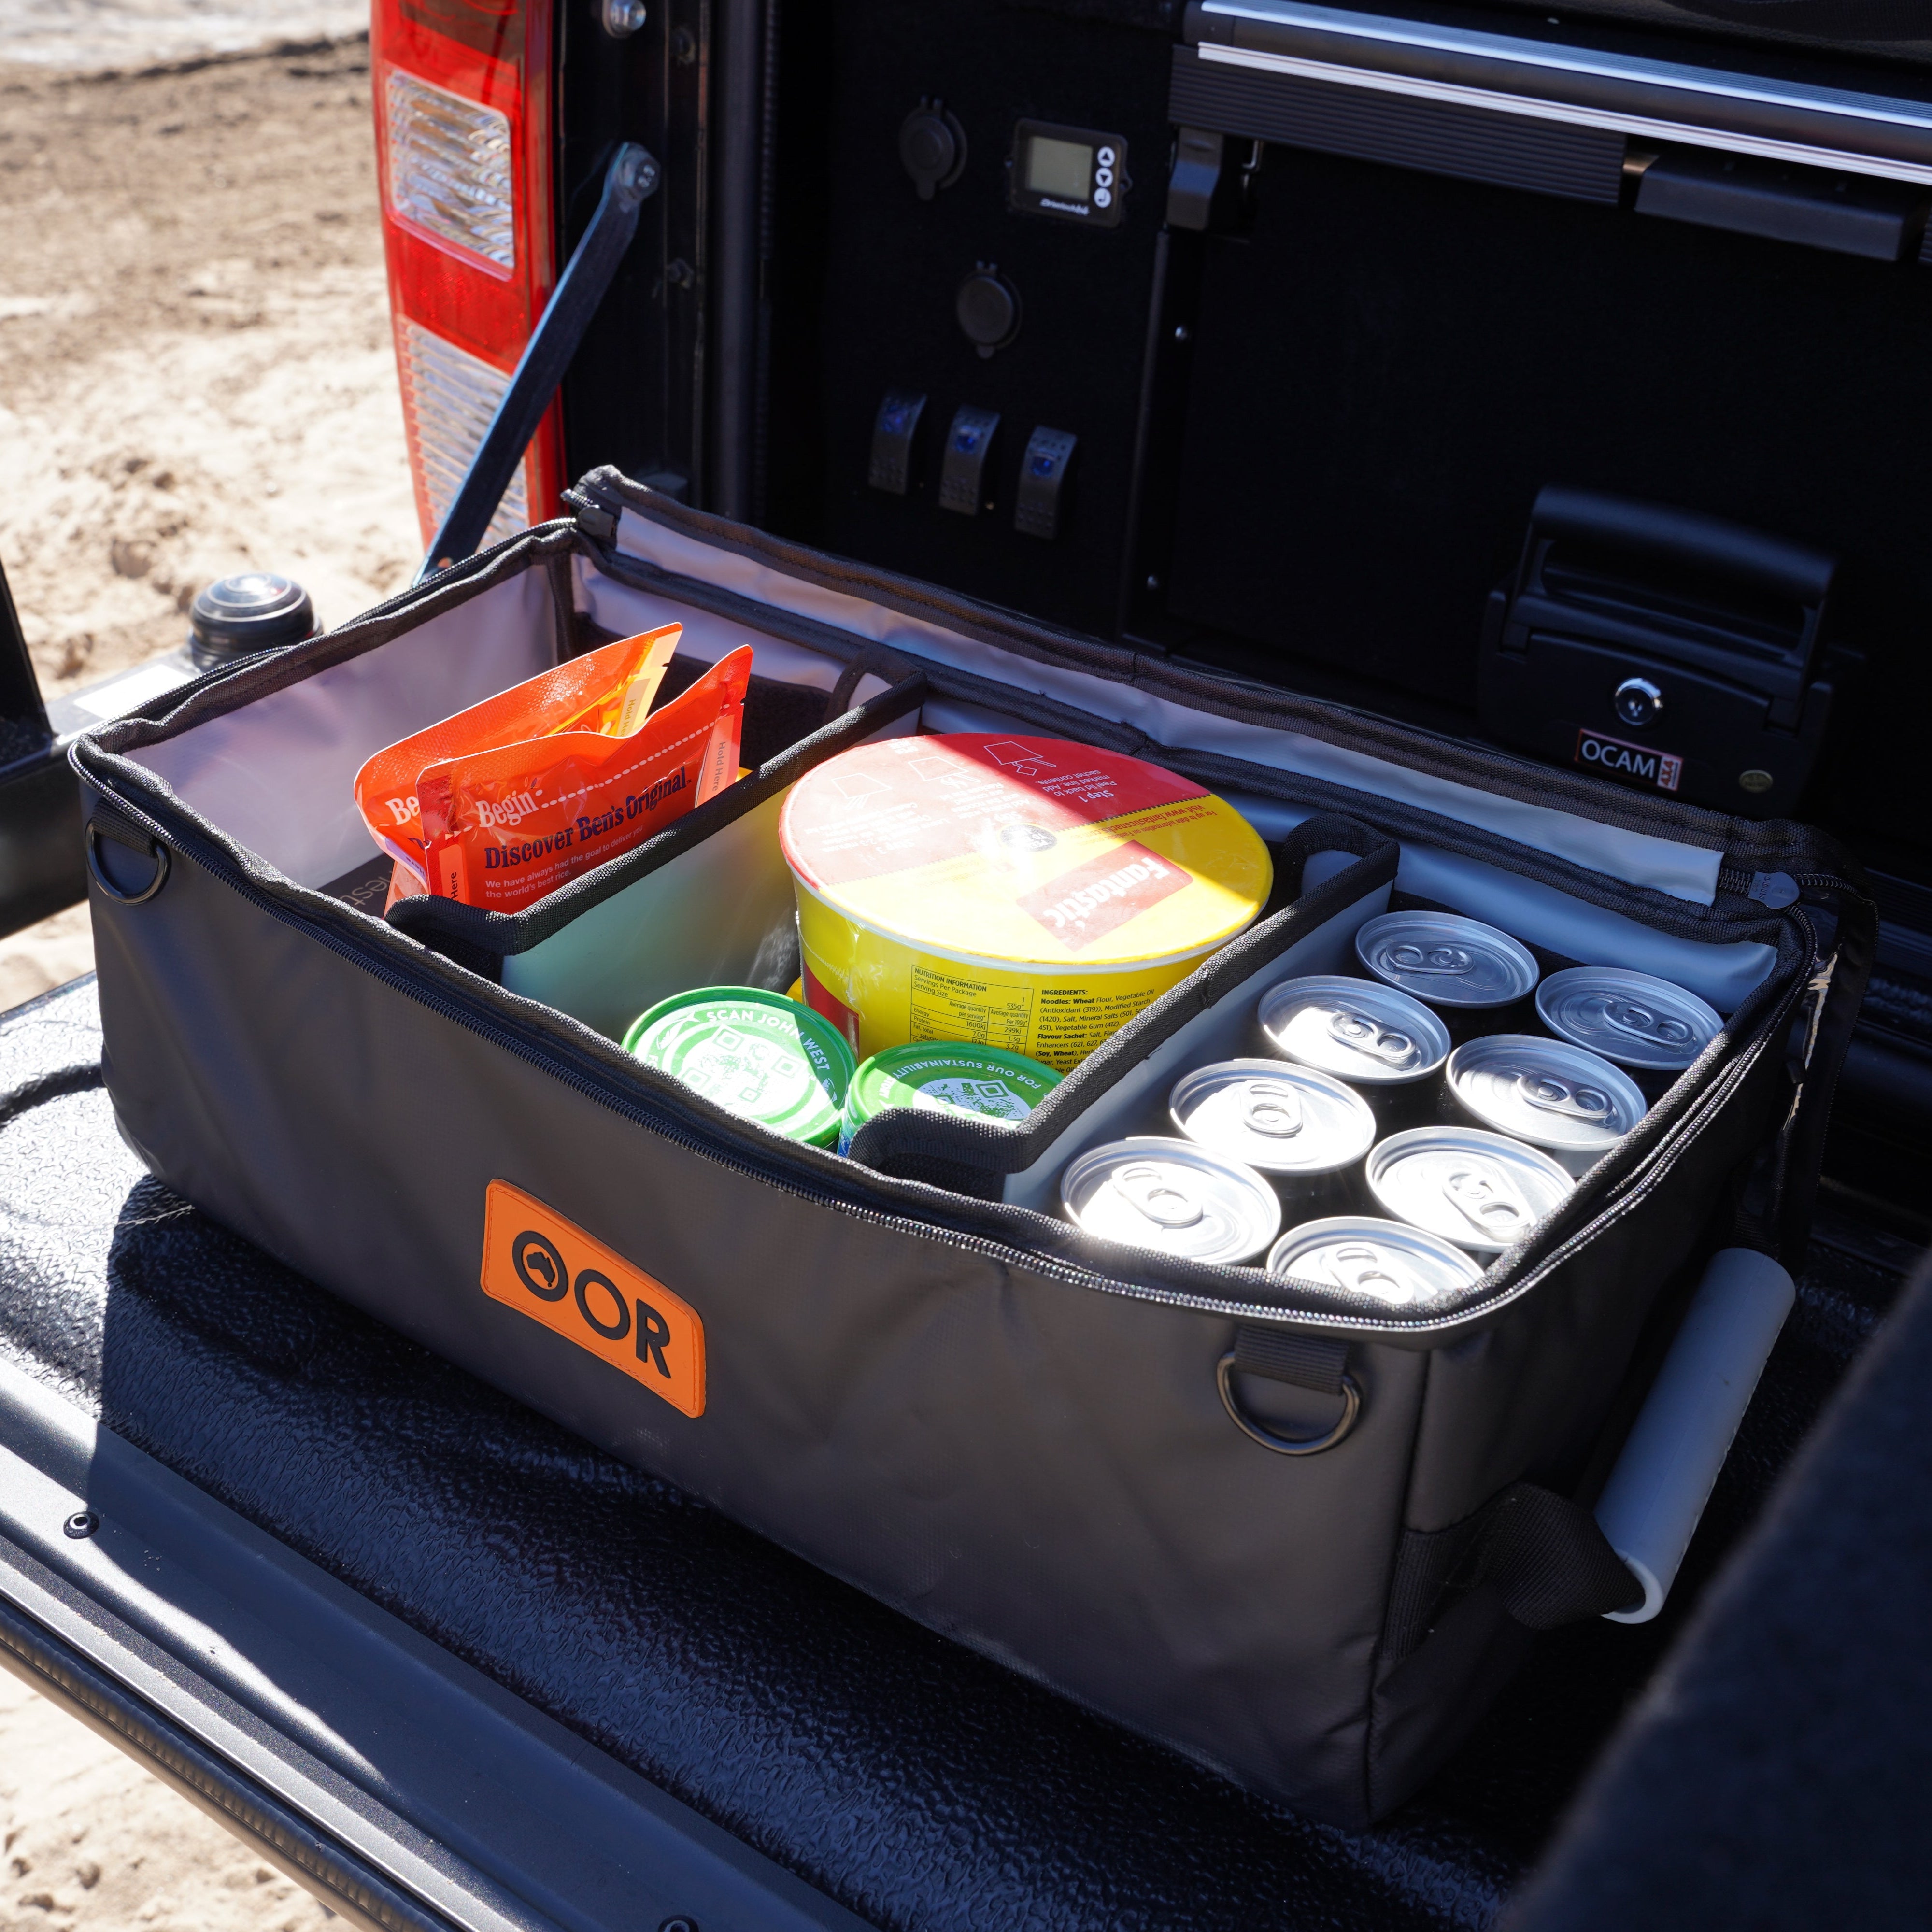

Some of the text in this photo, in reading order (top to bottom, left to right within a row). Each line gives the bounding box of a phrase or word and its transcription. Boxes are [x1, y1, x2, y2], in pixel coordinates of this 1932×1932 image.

[621, 699, 636, 737] Hold Her
[712, 742, 725, 791] Hold Here
[1581, 739, 1655, 779] OCAM
[1035, 770, 1101, 785] sachet contents.
[1079, 775, 1110, 784] marked
[1042, 784, 1061, 792] Add
[1063, 786, 1086, 795] back
[1087, 790, 1114, 800] Step
[476, 790, 539, 827] Begin
[1185, 804, 1205, 813] visit
[1195, 810, 1205, 818] up
[1141, 820, 1176, 832] information
[1176, 815, 1190, 825] date
[484, 827, 574, 869] Discover
[576, 805, 624, 841] Ben's
[485, 880, 501, 888] We
[504, 876, 525, 888] have
[527, 867, 553, 881] always
[555, 859, 570, 870] had
[571, 854, 583, 864] the
[585, 849, 601, 861] goal
[611, 833, 632, 847] deliver
[632, 825, 643, 838] you
[504, 884, 536, 897] world's
[538, 877, 554, 888] best
[555, 870, 571, 880] rice.
[1043, 857, 1170, 931] Fantastic
[914, 975, 938, 988] Servings
[952, 987, 977, 997] Package
[915, 968, 987, 992] NUTRITION INFORMATION
[914, 981, 935, 994] Serving
[937, 989, 948, 997] Size
[1116, 992, 1145, 1001] Vegetable
[949, 1000, 986, 1014] Average quantity
[1132, 998, 1150, 1007] Starch
[914, 1008, 930, 1017] Energy
[966, 1021, 986, 1030] 1600kj
[914, 1016, 930, 1025] Protein
[990, 1009, 1009, 1017] Average
[1120, 1010, 1134, 1019] (501,
[706, 1010, 830, 1071] SCAN JOHN WEST
[892, 1059, 982, 1079] SUSTAINABILITY
[986, 1064, 1014, 1077] OUR
[1017, 1074, 1041, 1089] FOR
[512, 1230, 671, 1379] OOR
